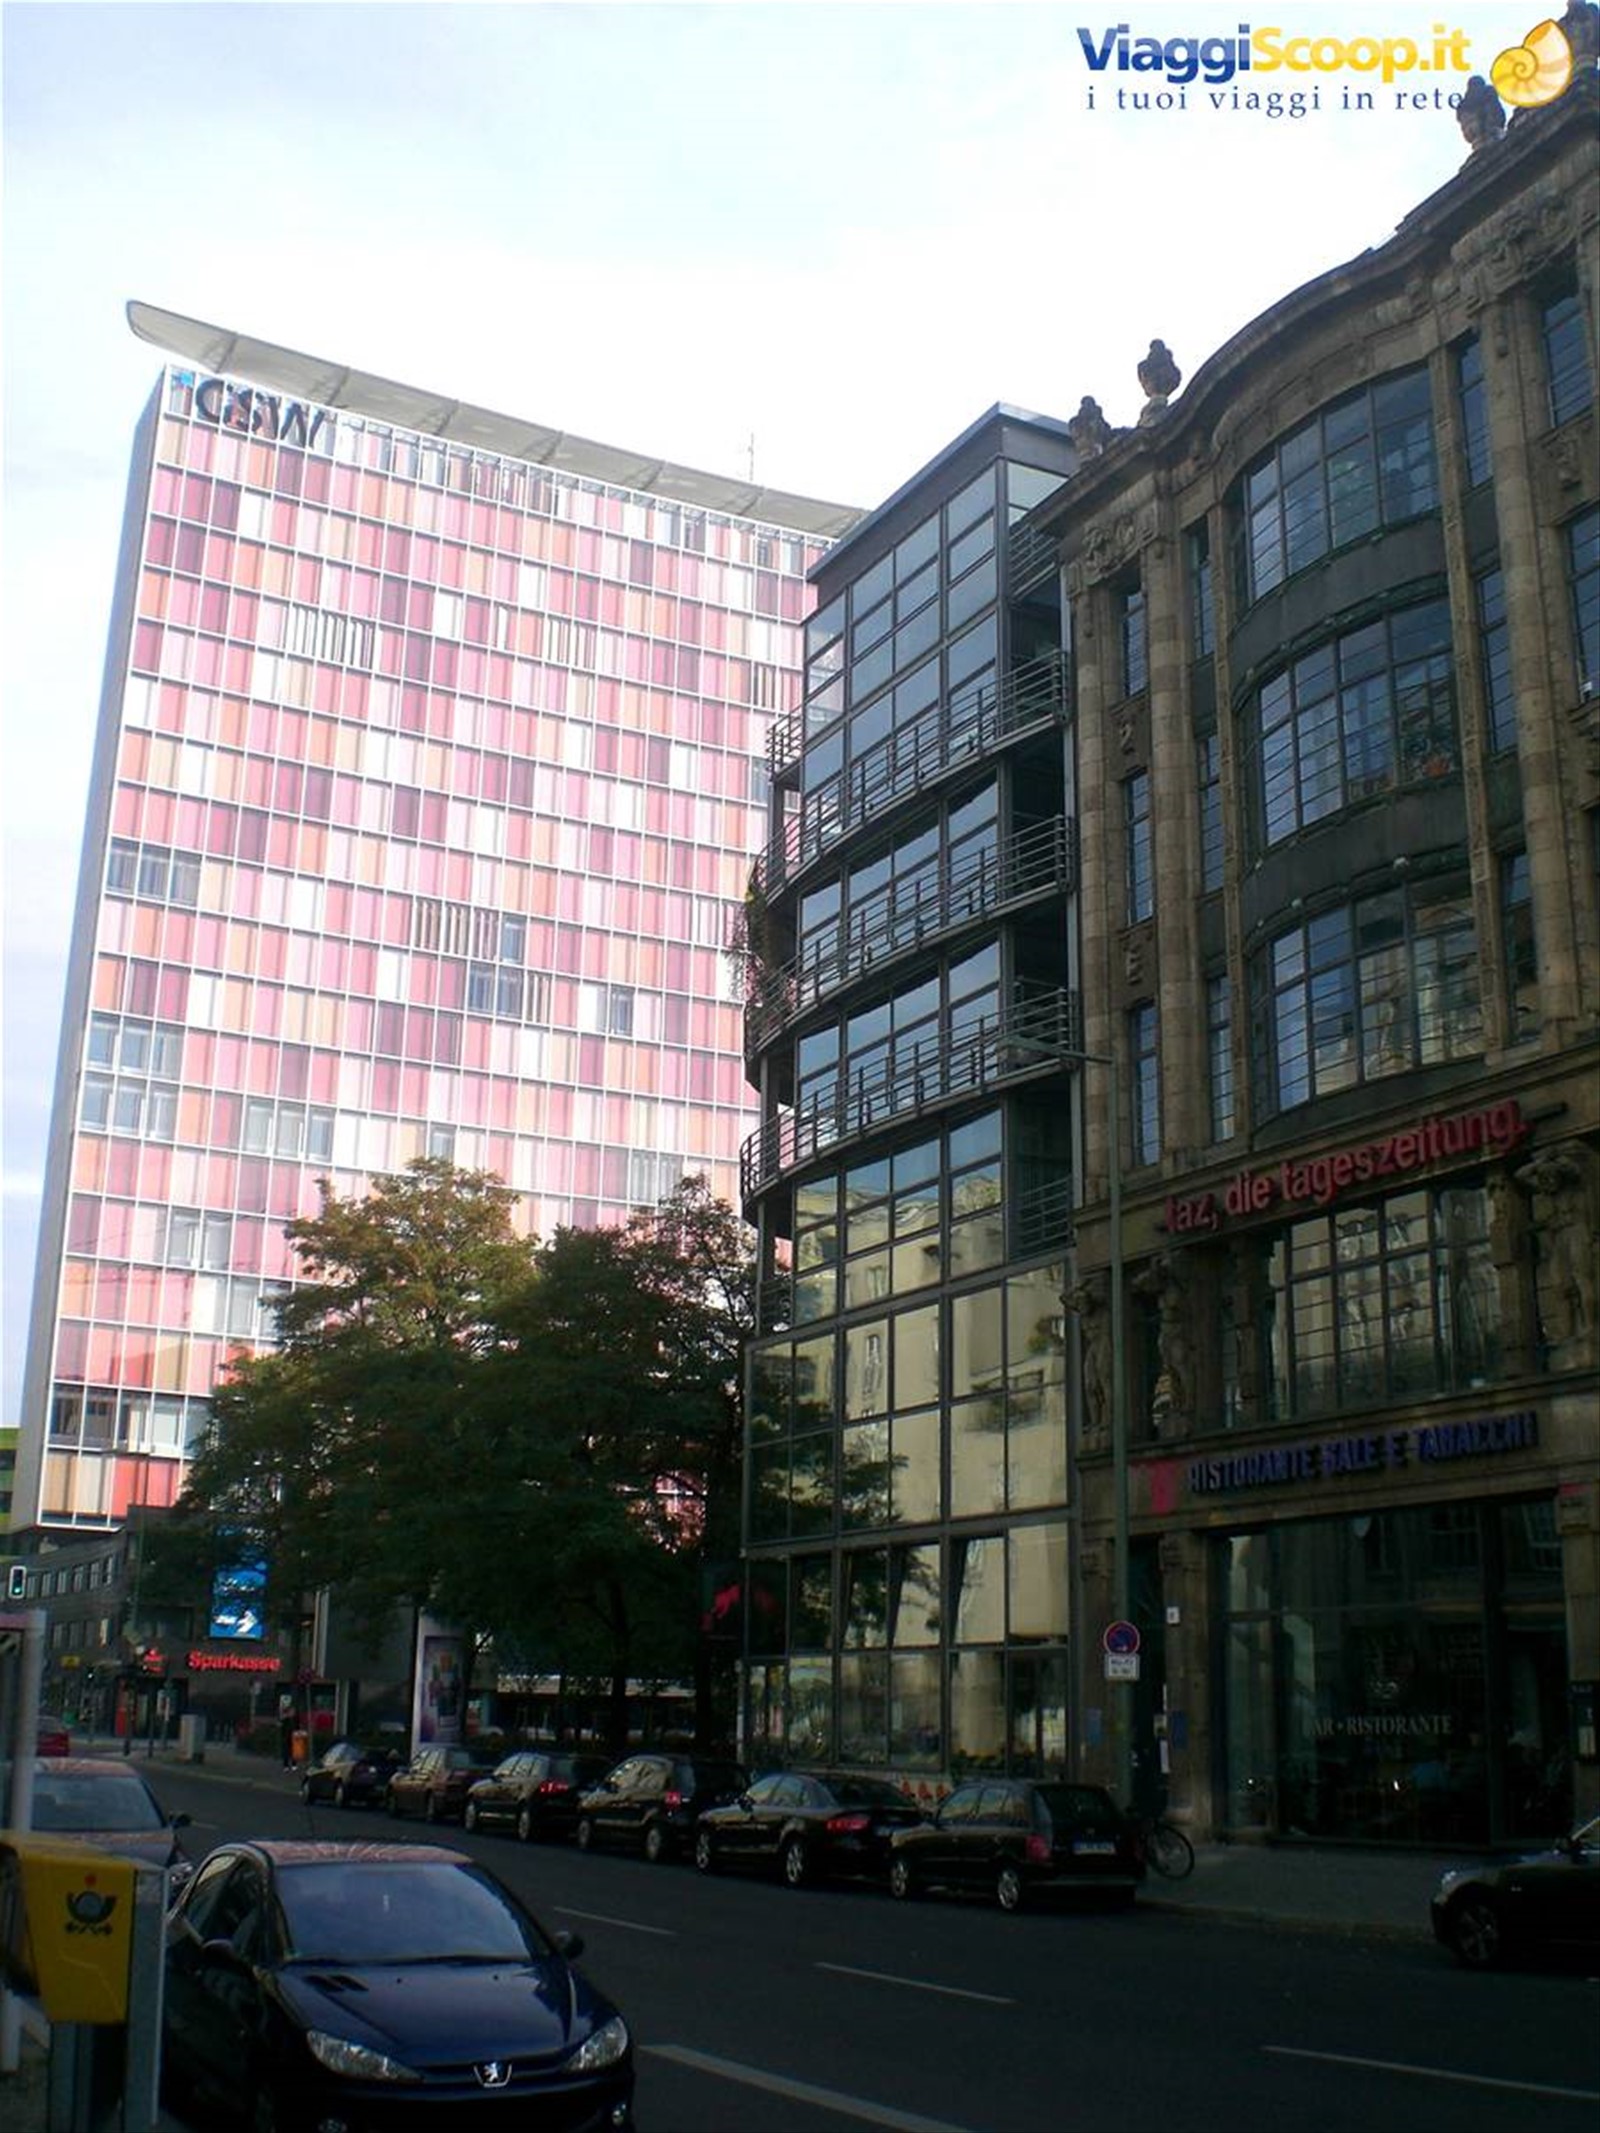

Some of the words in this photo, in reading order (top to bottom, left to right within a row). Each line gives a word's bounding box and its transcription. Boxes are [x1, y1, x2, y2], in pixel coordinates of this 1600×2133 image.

[1224, 1170, 1272, 1216] die
[1320, 1433, 1383, 1477] SALE
[187, 1649, 282, 1671] Sparkasse
[1346, 1713, 1453, 1736] RISTORANTE
